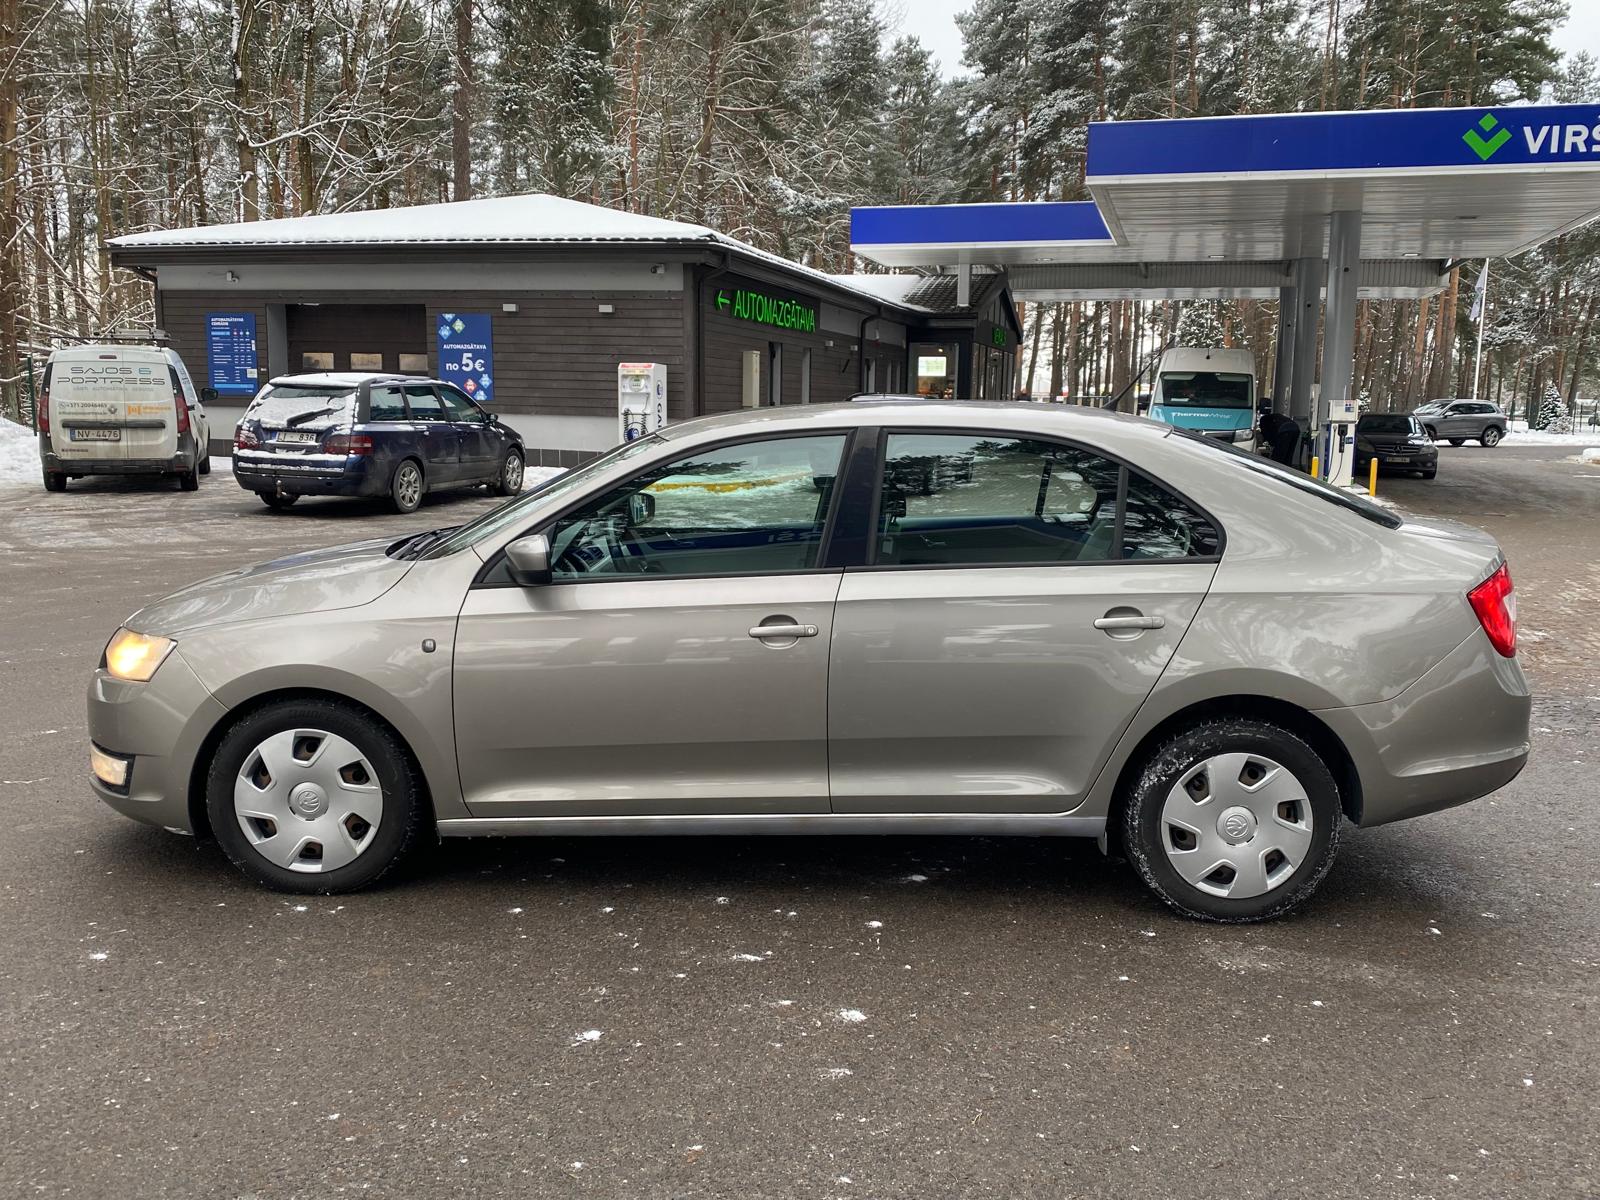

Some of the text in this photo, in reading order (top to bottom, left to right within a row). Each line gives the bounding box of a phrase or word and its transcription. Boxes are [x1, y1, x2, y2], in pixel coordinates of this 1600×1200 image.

[734, 289, 816, 332] AUTOMAZGĀTAVA
[445, 352, 485, 372] no 5€
[71, 366, 132, 374] SAJOS
[57, 376, 166, 386] PORTRESS
